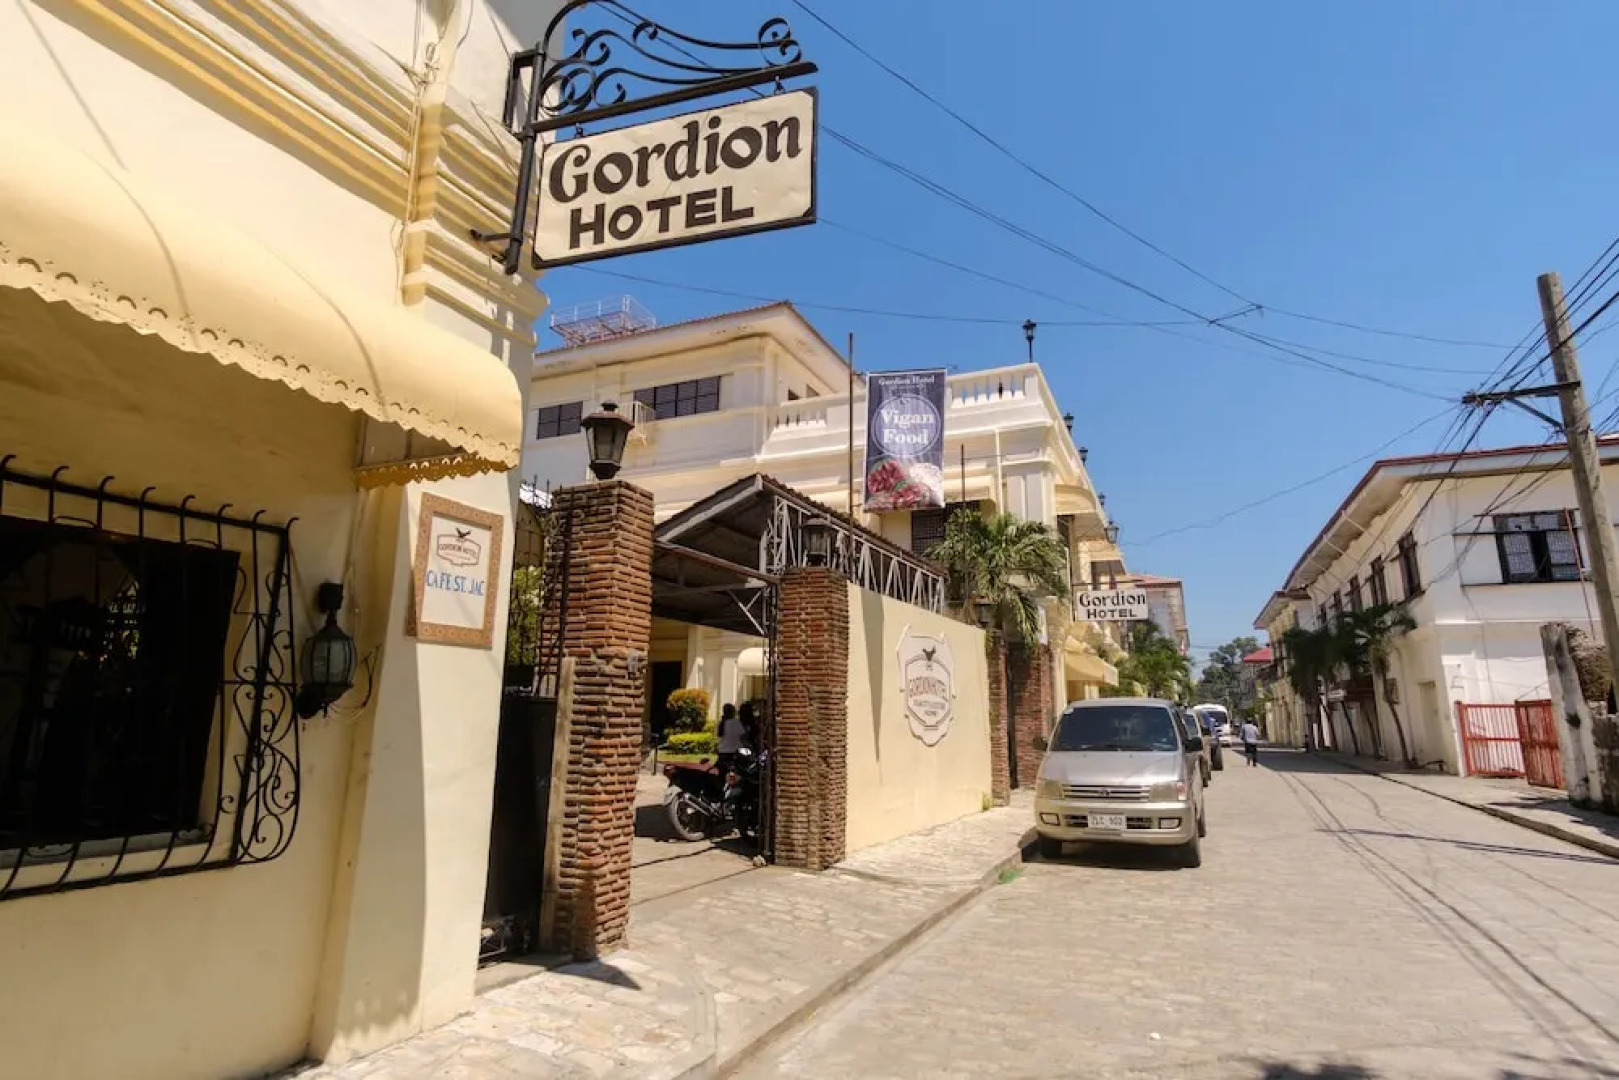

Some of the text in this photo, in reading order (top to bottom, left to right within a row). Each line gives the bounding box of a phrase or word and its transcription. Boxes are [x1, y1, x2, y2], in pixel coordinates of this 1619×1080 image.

[550, 115, 802, 203] Gordion
[569, 186, 754, 250] HOTEL
[880, 409, 935, 429] Vigan
[883, 428, 929, 444] Food
[1079, 590, 1146, 608] Gordion
[1086, 608, 1137, 619] HOTEL
